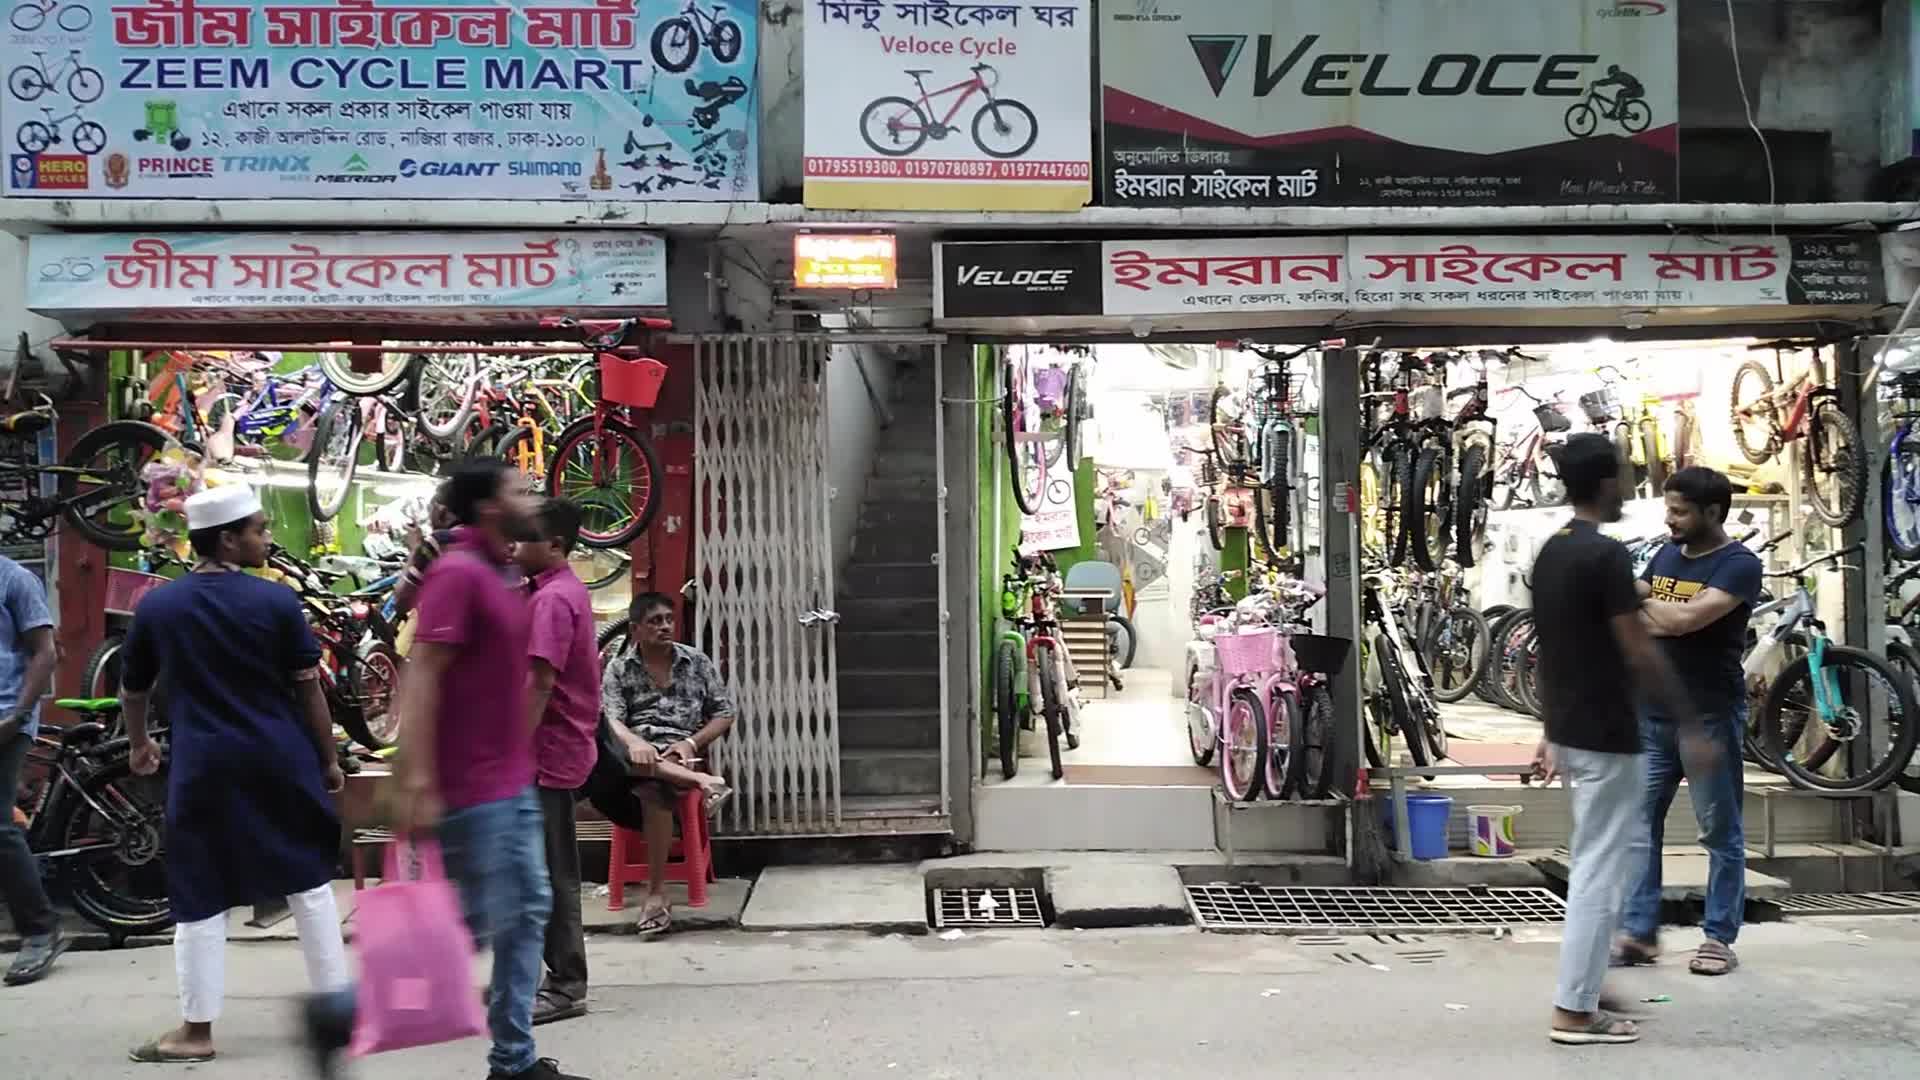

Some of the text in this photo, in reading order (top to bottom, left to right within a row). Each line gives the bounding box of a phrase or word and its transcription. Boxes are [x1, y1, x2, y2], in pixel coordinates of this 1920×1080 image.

[112, 0, 637, 50] জীম সাইকেল মার্ট
[816, 0, 1078, 31] মিন্টু সাইকেল ঘর
[880, 35, 1017, 59] Veloce Cycle
[120, 57, 642, 90] ZEEM CYCLE MART
[224, 97, 572, 120] এখানে সকল প্রকার সাইকেল পাওয়া যায়
[235, 126, 270, 148] কাজী
[275, 126, 350, 147] আলাউদ্দিন
[400, 126, 447, 148] নাজিরা
[39, 160, 86, 173] HERO
[138, 157, 213, 173] PRINCE
[220, 156, 311, 172] TRINX
[420, 162, 500, 177] GIANT
[508, 161, 582, 177] SHIMANO
[39, 174, 86, 184] CYCLES
[315, 174, 397, 184] MERIDA
[1115, 168, 1318, 199] ইমরান সাইকেল মার্ট
[104, 238, 562, 293] জীম সাইকেল মার্ট
[957, 265, 1073, 286] VELOCE
[1109, 245, 1780, 289] ইমরান সাইকেল মার্ট
[1183, 293, 1232, 305] এখানে
[1400, 291, 1425, 303] সহ
[1431, 290, 1469, 303] সকল
[1477, 289, 1526, 302] ধরনের
[1533, 288, 1595, 302] সাইকেল
[1602, 289, 1648, 301] পাওয়া
